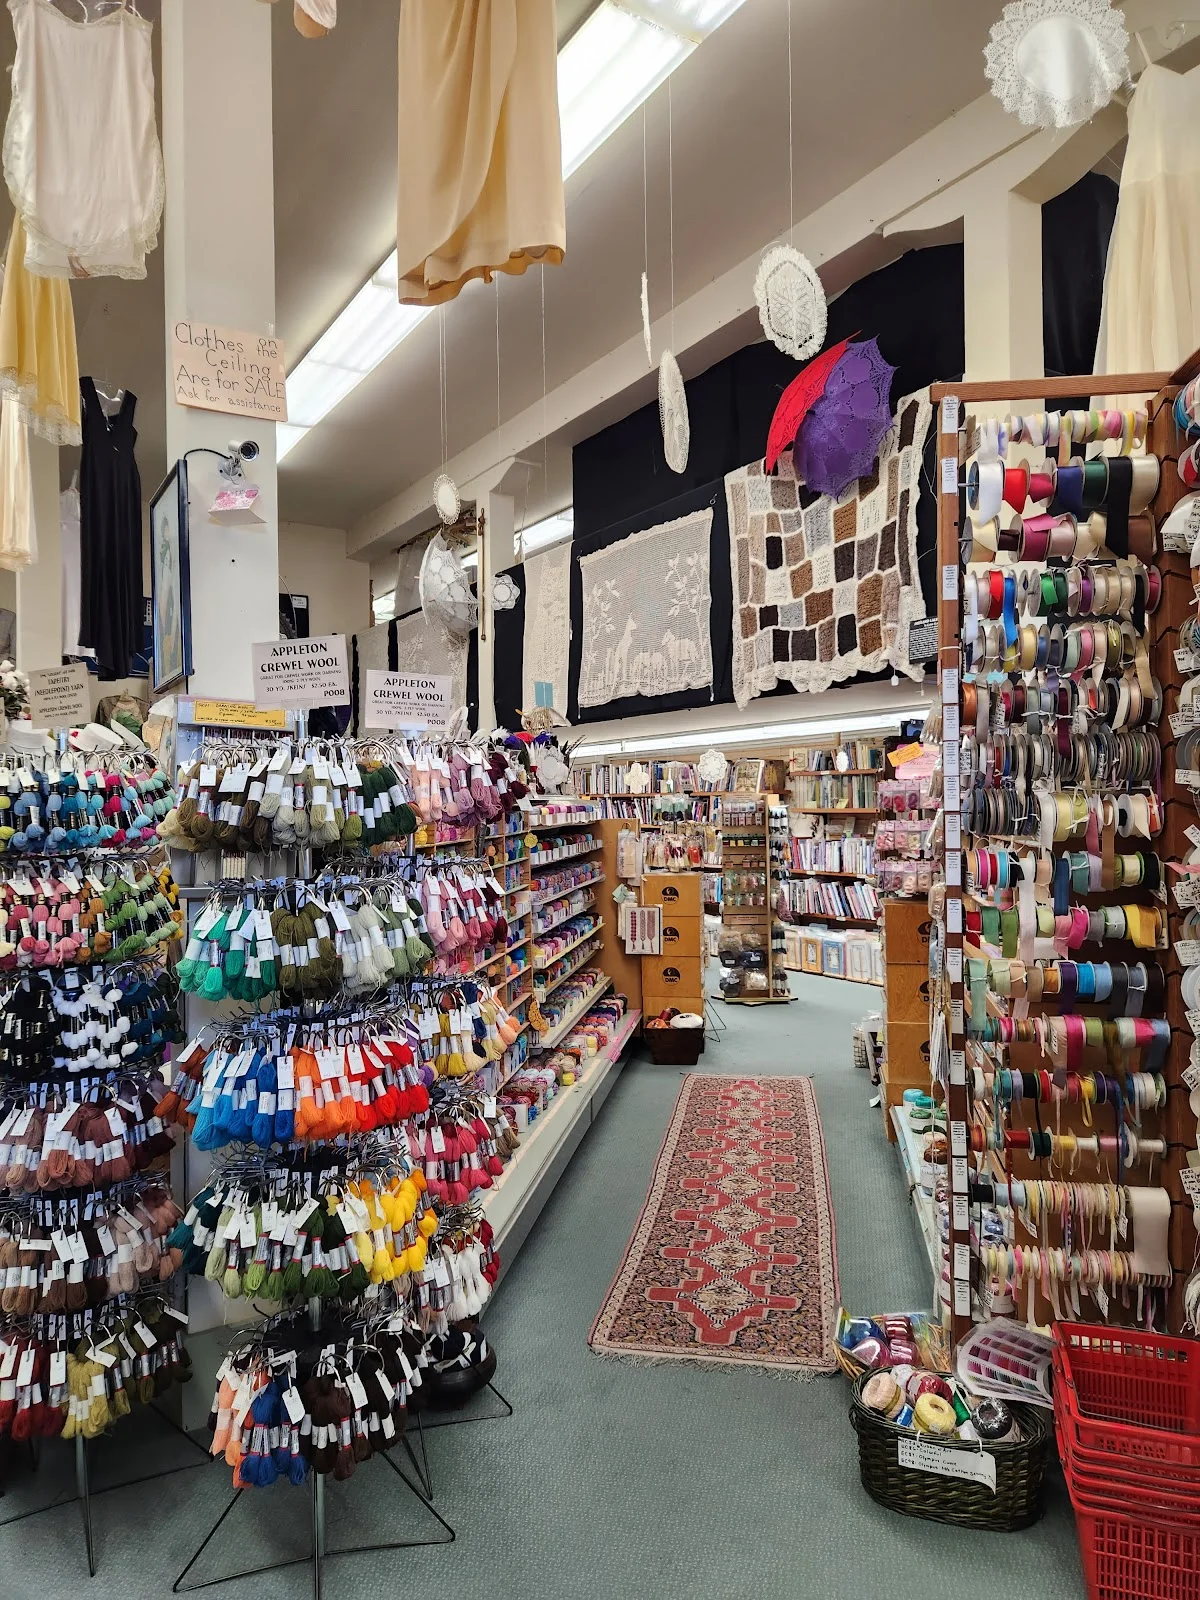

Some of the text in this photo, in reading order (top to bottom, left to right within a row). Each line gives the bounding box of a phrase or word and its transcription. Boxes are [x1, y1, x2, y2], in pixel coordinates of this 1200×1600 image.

[175, 322, 278, 353] Clothes on
[256, 344, 278, 359] the
[205, 348, 271, 382] Ceiling
[176, 364, 285, 399] Are for SALE
[177, 385, 281, 413] Ask for assistance
[271, 643, 328, 657] APPLETON
[260, 657, 340, 673] CREWEL WOOL
[384, 678, 436, 689] APPLETON
[323, 689, 345, 697] P008
[373, 689, 444, 702] CREWEL WOOL
